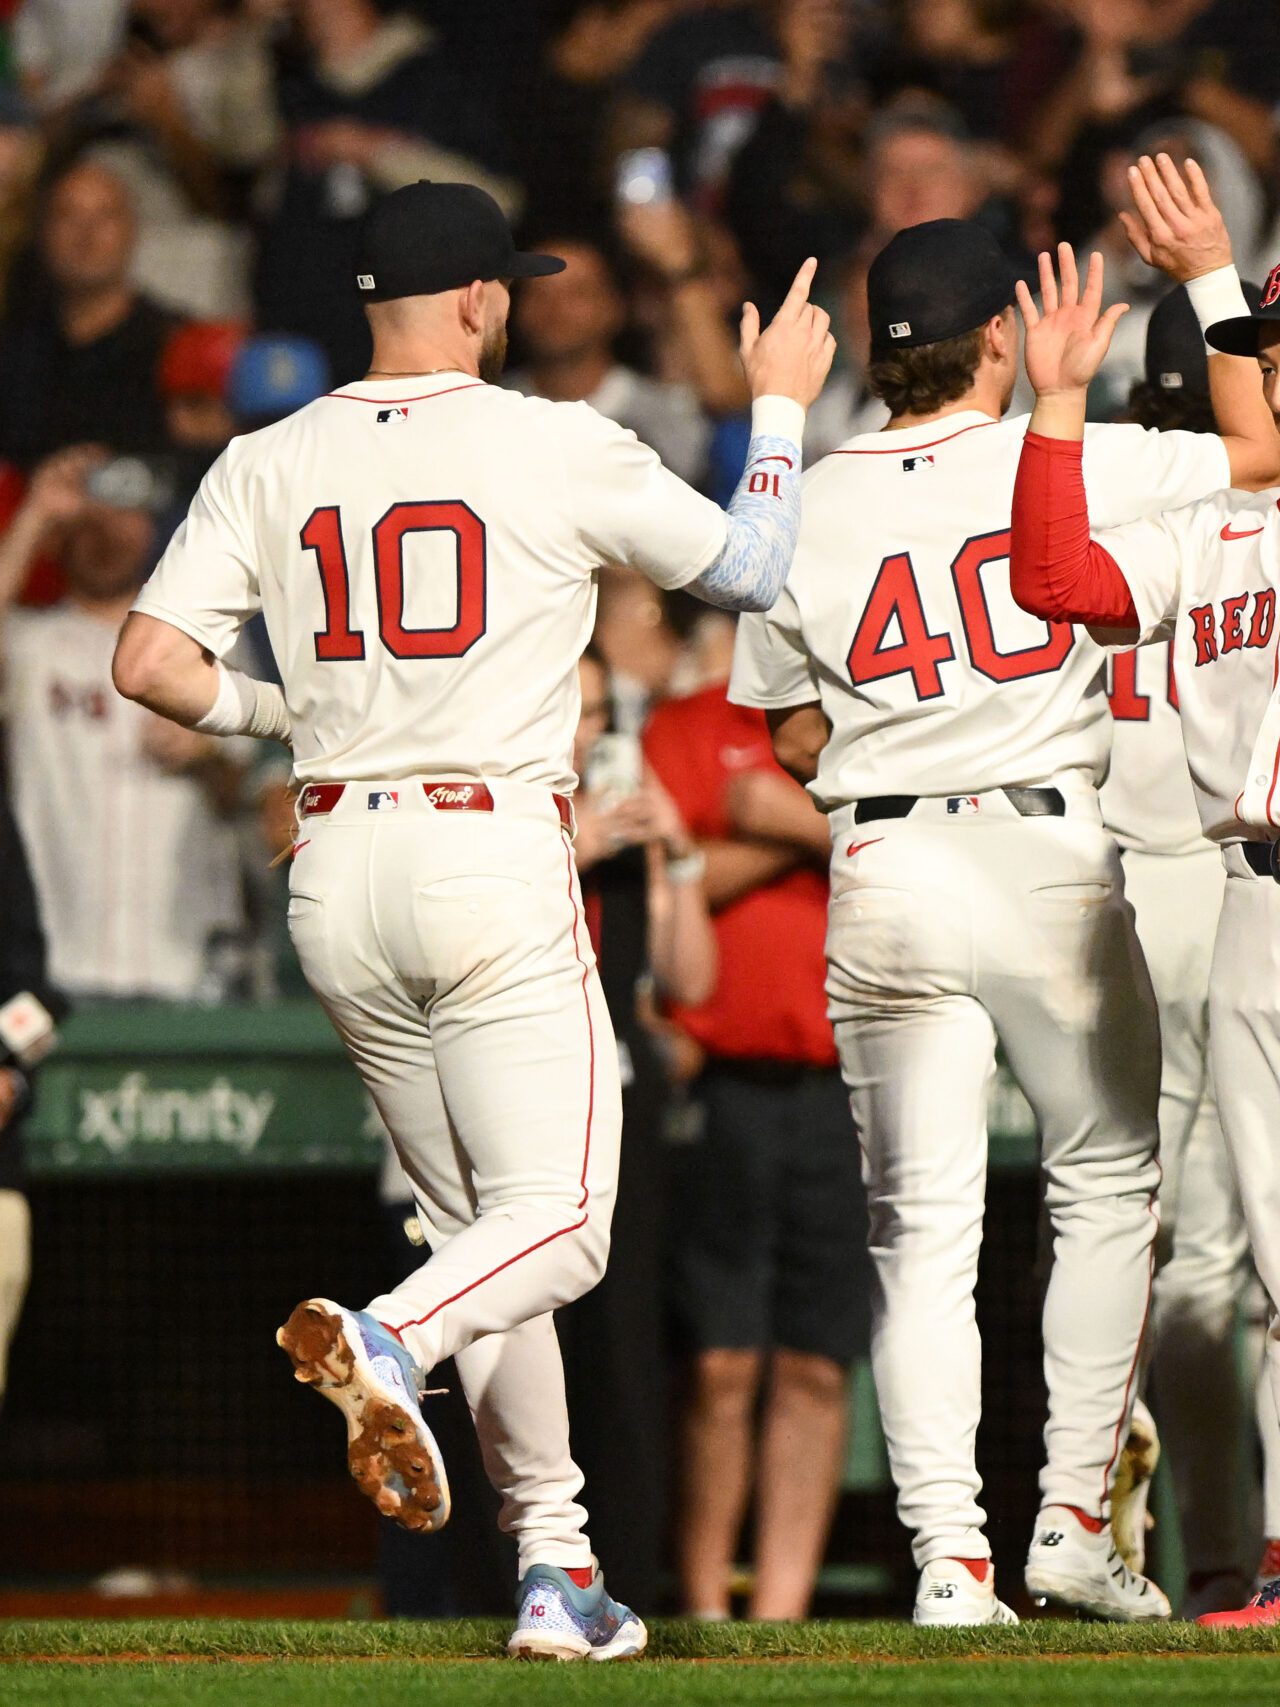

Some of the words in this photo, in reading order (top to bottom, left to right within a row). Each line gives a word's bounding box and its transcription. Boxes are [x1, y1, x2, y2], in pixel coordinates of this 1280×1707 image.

[299, 499, 487, 662] 10
[846, 527, 1076, 702] 40
[1188, 587, 1277, 667] RED
[428, 786, 474, 805] STORY
[78, 1071, 276, 1155] xfinity
